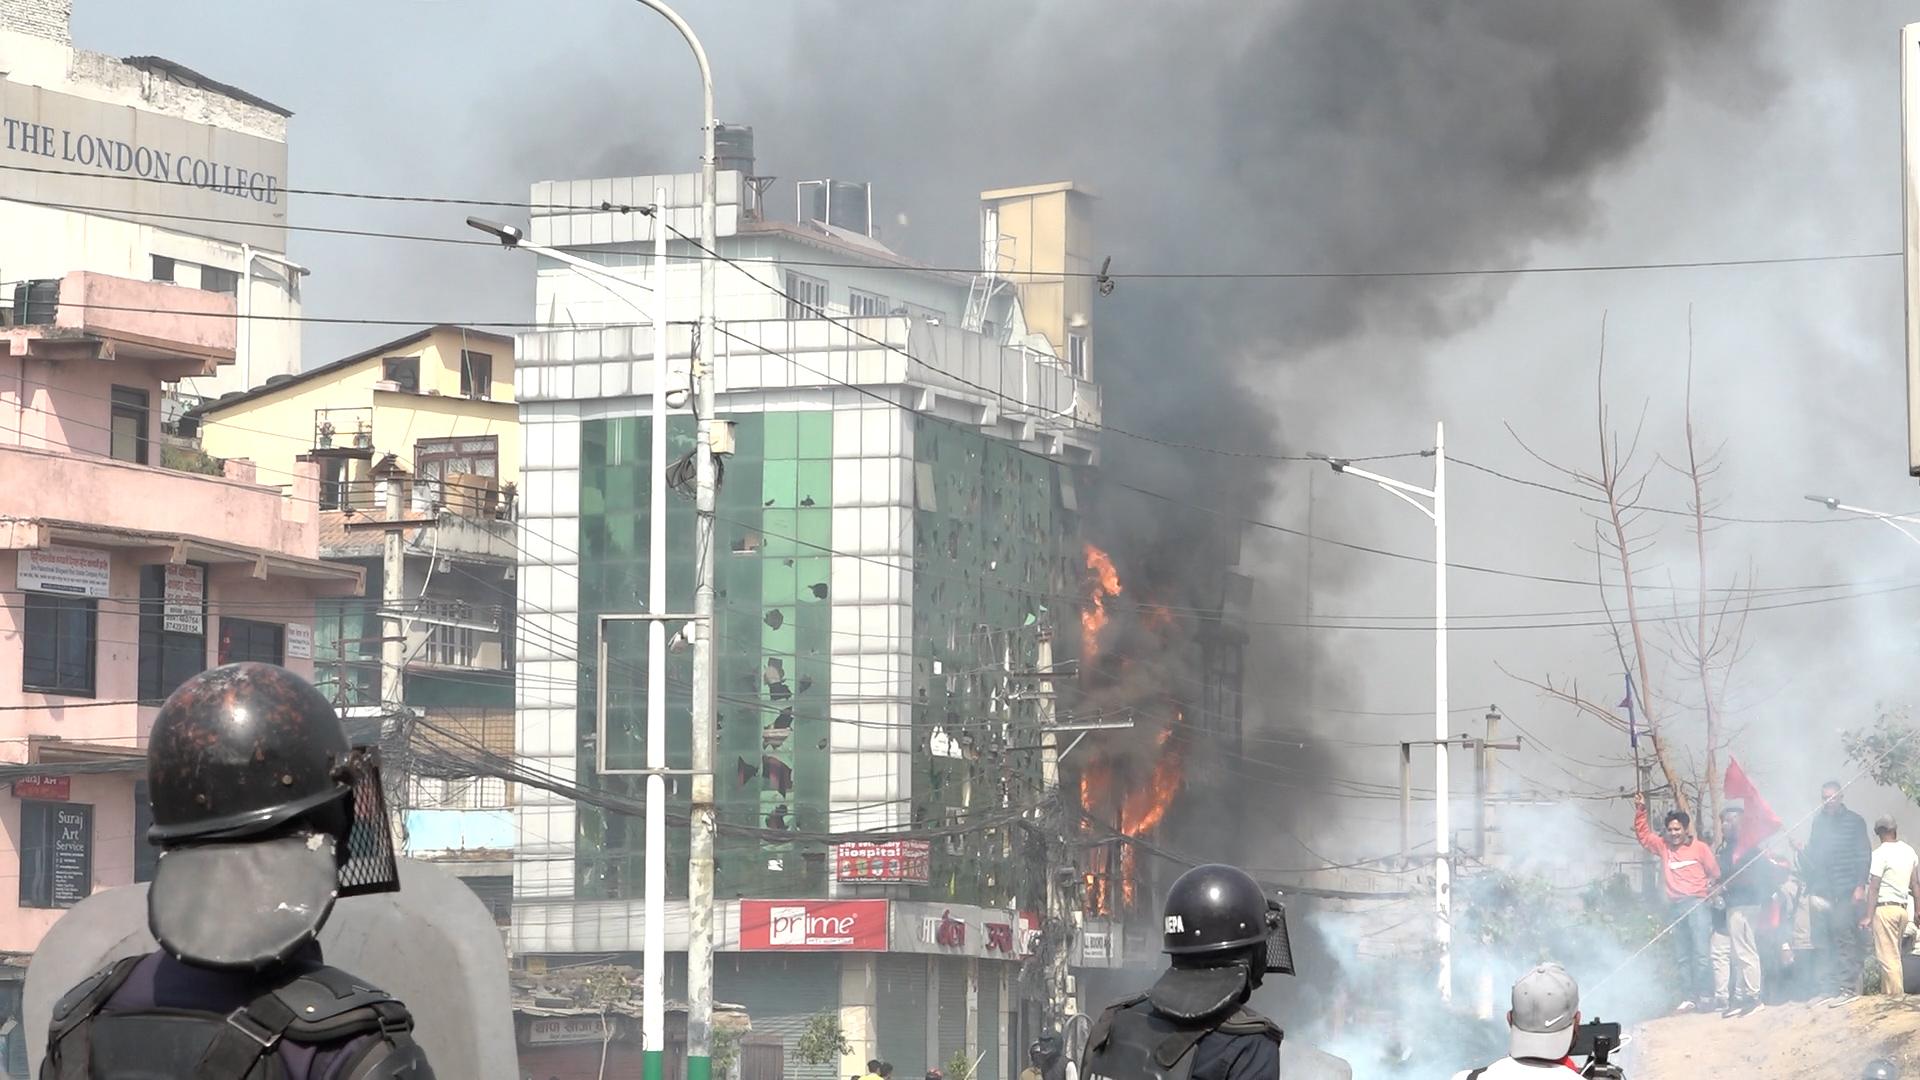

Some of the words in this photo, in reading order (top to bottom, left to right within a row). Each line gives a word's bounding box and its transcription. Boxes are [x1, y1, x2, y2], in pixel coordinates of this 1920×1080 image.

[4, 117, 55, 158] THE
[62, 130, 171, 182] LONDON
[176, 155, 278, 205] COLLEGE
[58, 810, 83, 830] Suraj
[62, 827, 79, 840] Art
[56, 839, 85, 852] Service
[839, 847, 901, 858] Hospital
